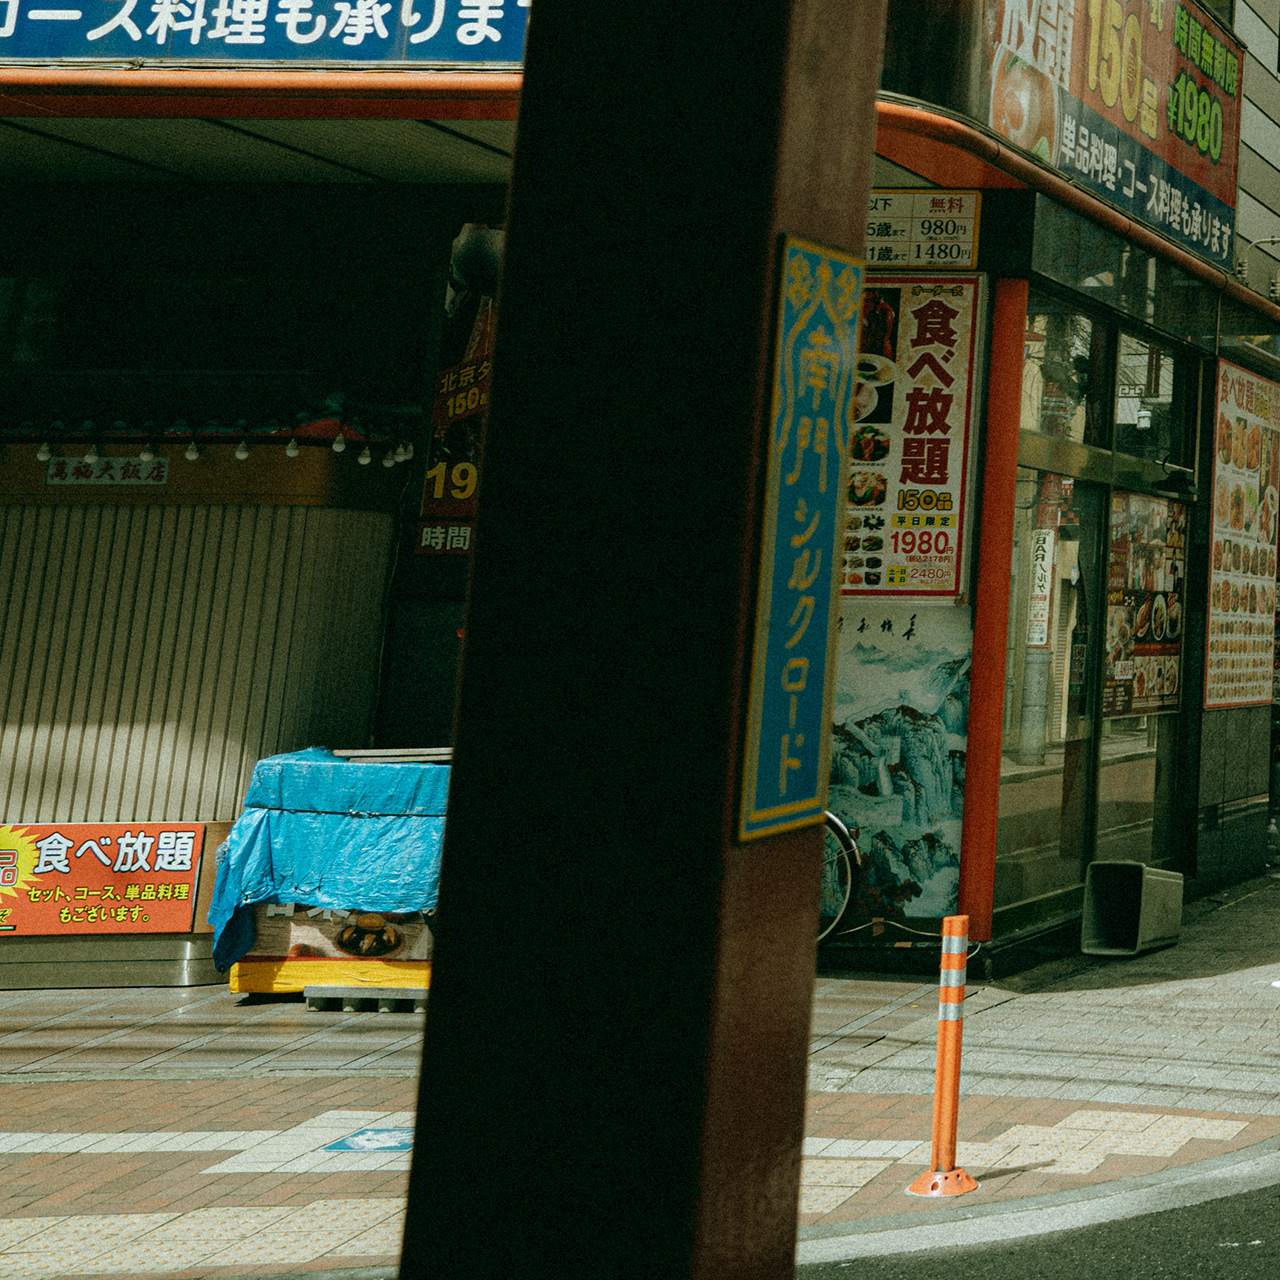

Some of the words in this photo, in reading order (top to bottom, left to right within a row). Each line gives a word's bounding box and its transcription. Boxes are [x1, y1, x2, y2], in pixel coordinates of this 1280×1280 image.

[1174, 0, 1238, 99] 時間無制限
[1167, 68, 1223, 164] ¥1980
[1060, 114, 1232, 260] 単品料理・コース料理も承ります
[929, 197, 965, 214] 無料
[920, 220, 966, 236] 980円
[865, 246, 907, 261] 1歳まで
[915, 244, 971, 260] 1480円
[911, 285, 964, 297] オーダー式
[899, 299, 960, 486] 食べ放題
[897, 489, 953, 511] 150品
[897, 516, 951, 526] 平日限定
[420, 525, 472, 552] 時間
[890, 531, 954, 554] 1980円
[778, 325, 842, 796] 南門シルクロード
[910, 568, 951, 579] 2480円
[34, 831, 196, 875] 食べ放題
[27, 883, 189, 902] セット、コース、単品料理
[59, 904, 151, 923] もございます。
